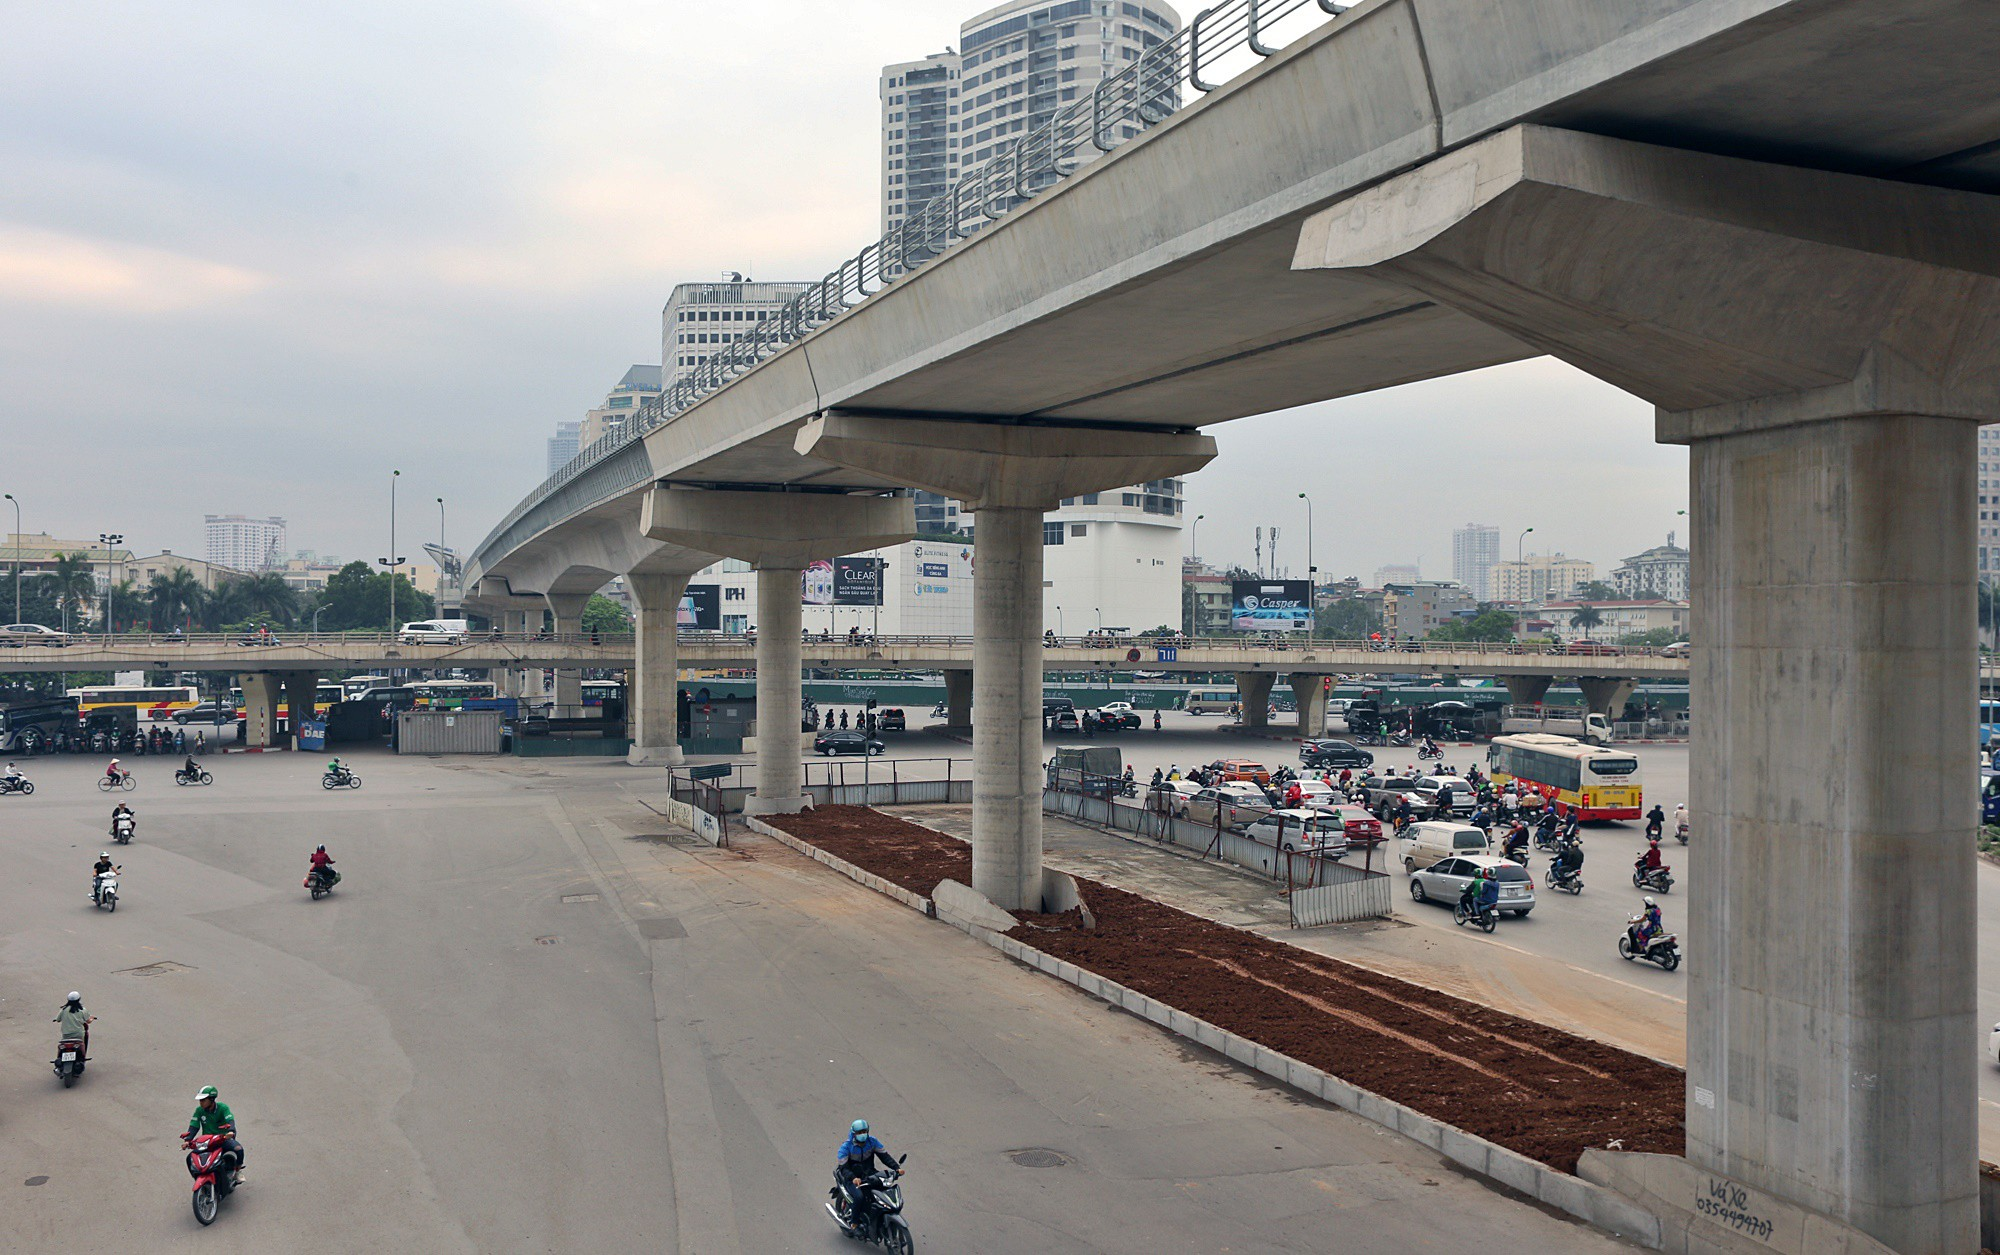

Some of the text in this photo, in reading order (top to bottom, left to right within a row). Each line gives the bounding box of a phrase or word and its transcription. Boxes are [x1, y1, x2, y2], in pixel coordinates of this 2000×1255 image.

[844, 569, 875, 580] CLEAR
[725, 588, 745, 600] IPH
[1261, 598, 1302, 610] Casper
